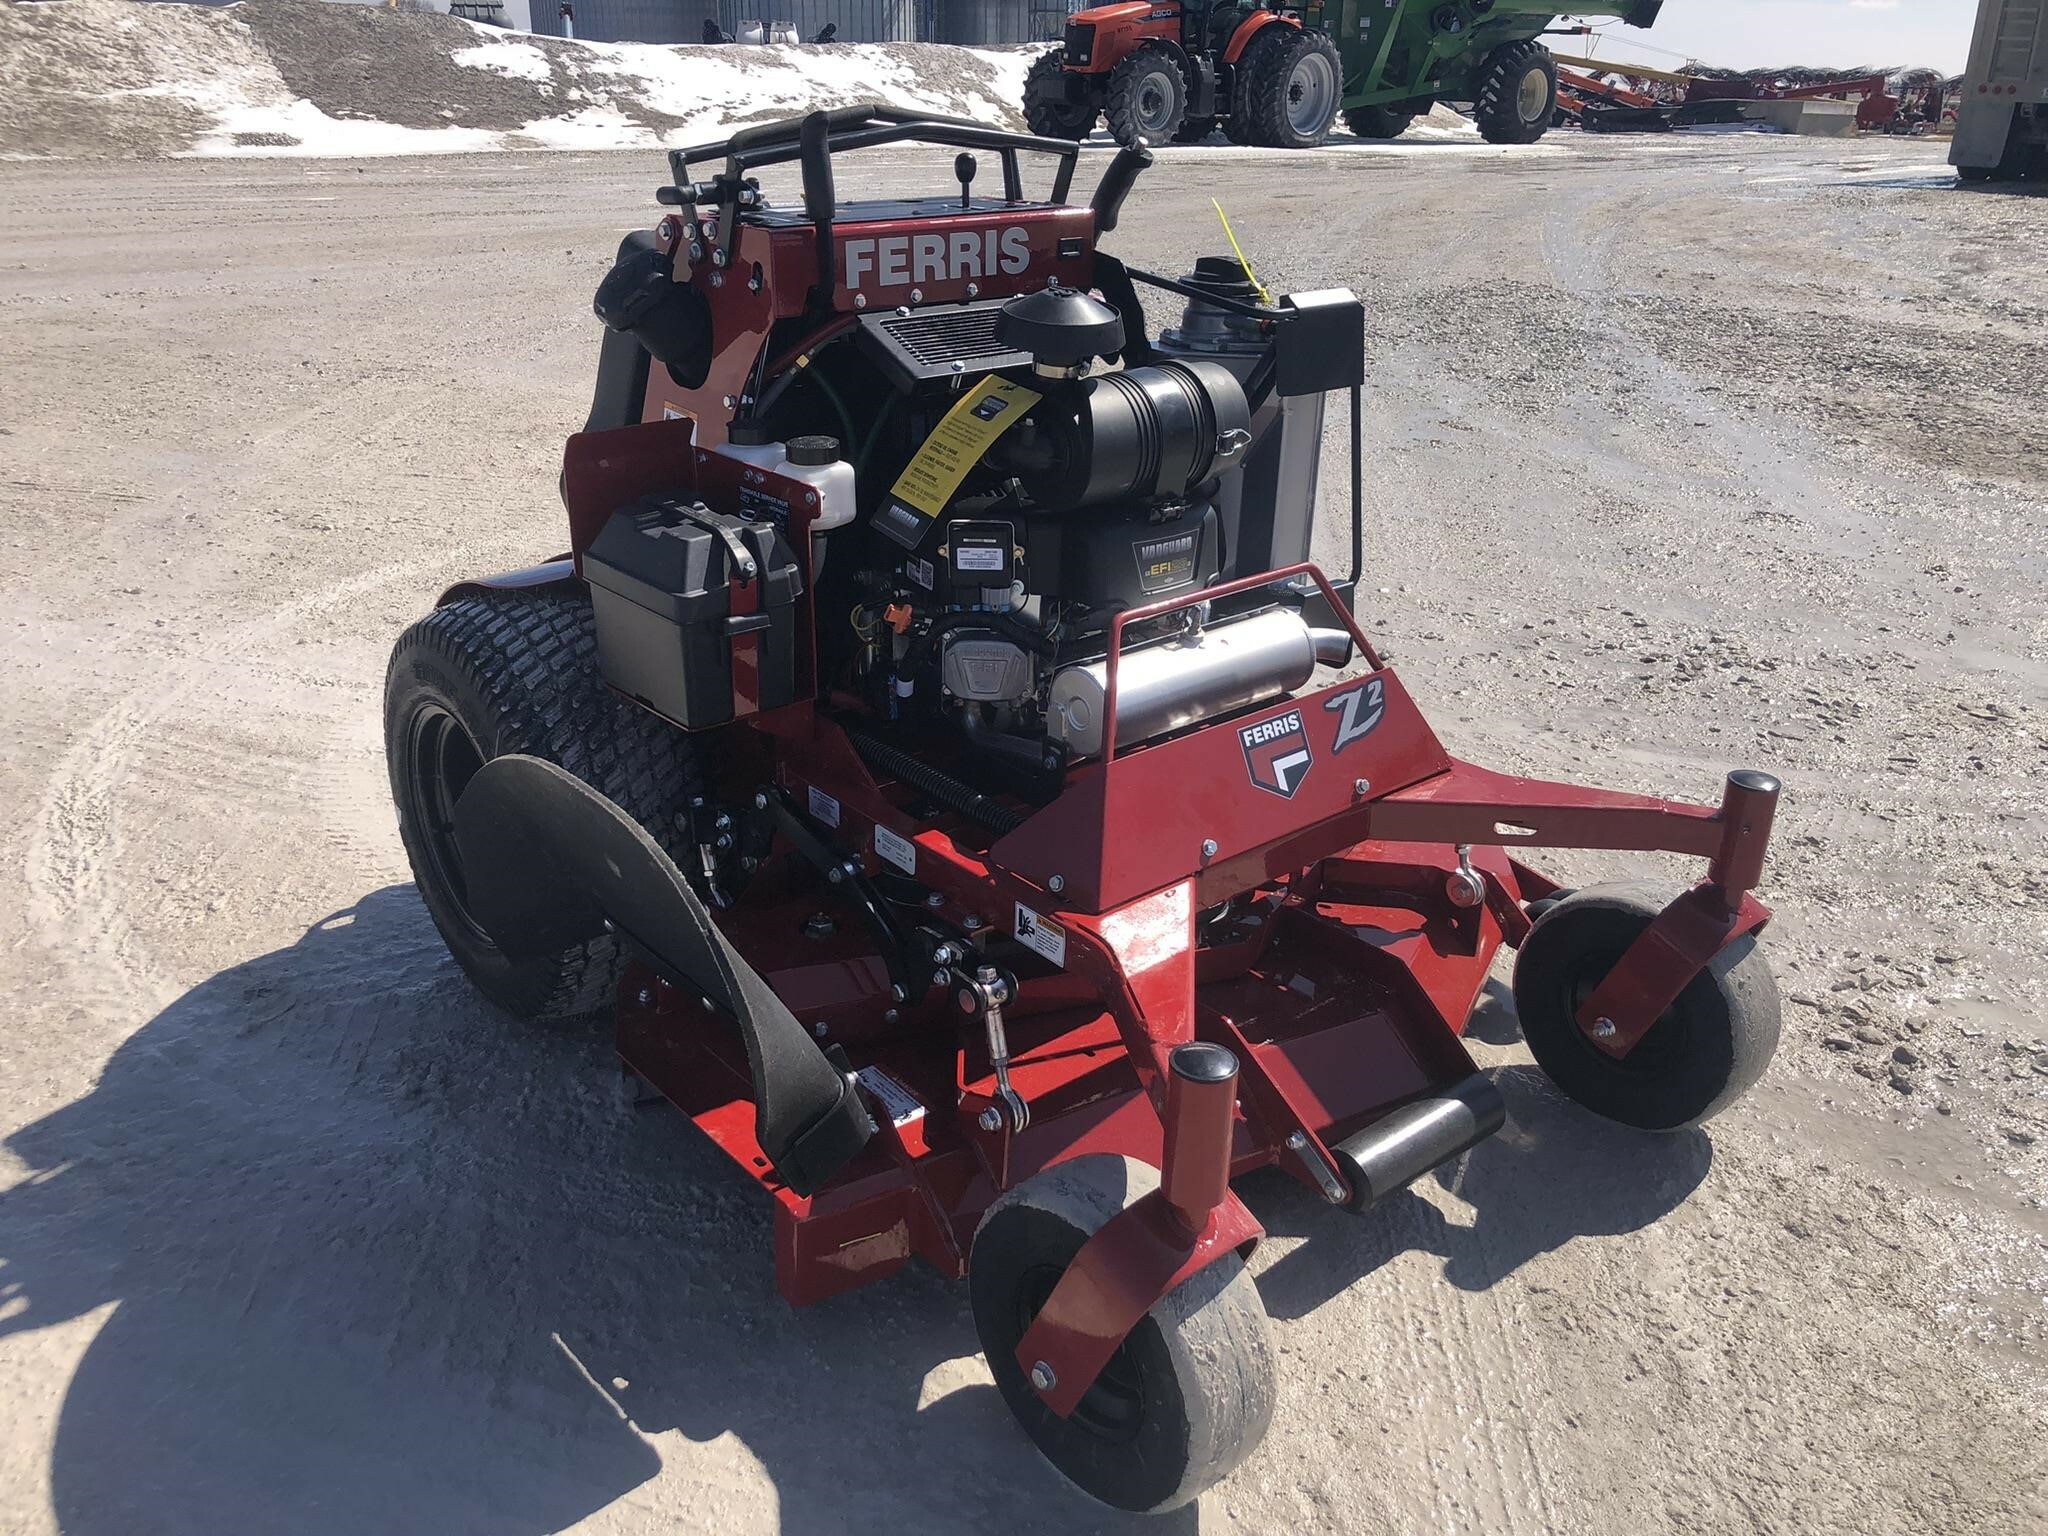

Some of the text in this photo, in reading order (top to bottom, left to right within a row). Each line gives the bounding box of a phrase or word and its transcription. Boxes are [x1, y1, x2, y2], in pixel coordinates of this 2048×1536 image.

[1152, 9, 1172, 18] AGCO
[845, 226, 1030, 289] FERRIS
[1141, 536, 1193, 560] VANGUARD
[1150, 561, 1172, 576] EFI
[1242, 712, 1300, 747] FERRIS
